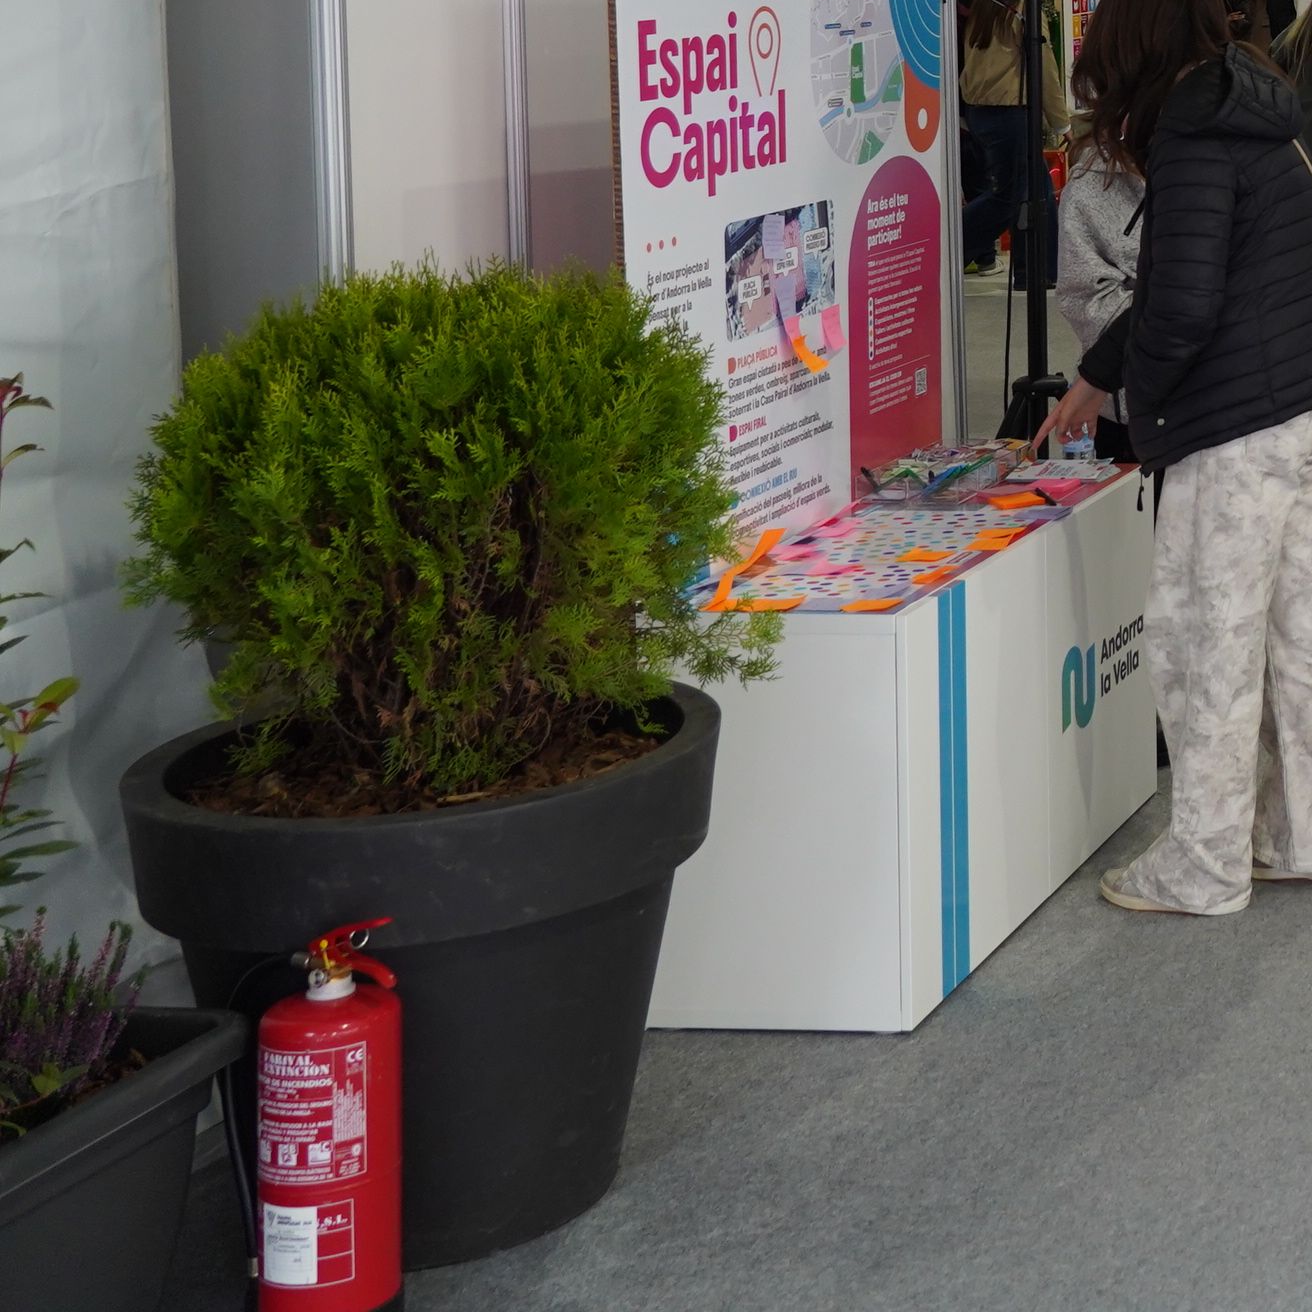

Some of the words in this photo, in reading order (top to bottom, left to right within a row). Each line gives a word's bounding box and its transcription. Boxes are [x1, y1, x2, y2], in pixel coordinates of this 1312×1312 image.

[638, 11, 738, 115] Espai
[640, 89, 786, 197] Capital
[867, 199, 878, 214] Ara
[880, 196, 889, 210] és
[889, 193, 896, 208] el
[897, 194, 909, 207] teu
[867, 211, 896, 231] moment
[896, 208, 906, 223] de
[867, 224, 902, 251] participar!
[676, 263, 703, 280] projecte
[704, 258, 709, 270] al
[692, 280, 697, 291] la
[698, 276, 712, 289] Vella
[687, 299, 692, 311] la
[728, 377, 742, 389] Gran
[739, 421, 753, 436] ESPAI
[753, 416, 767, 431] FIRAL
[1100, 613, 1144, 664] Andorra
[1101, 672, 1111, 697] la
[1113, 649, 1139, 685] Vella
